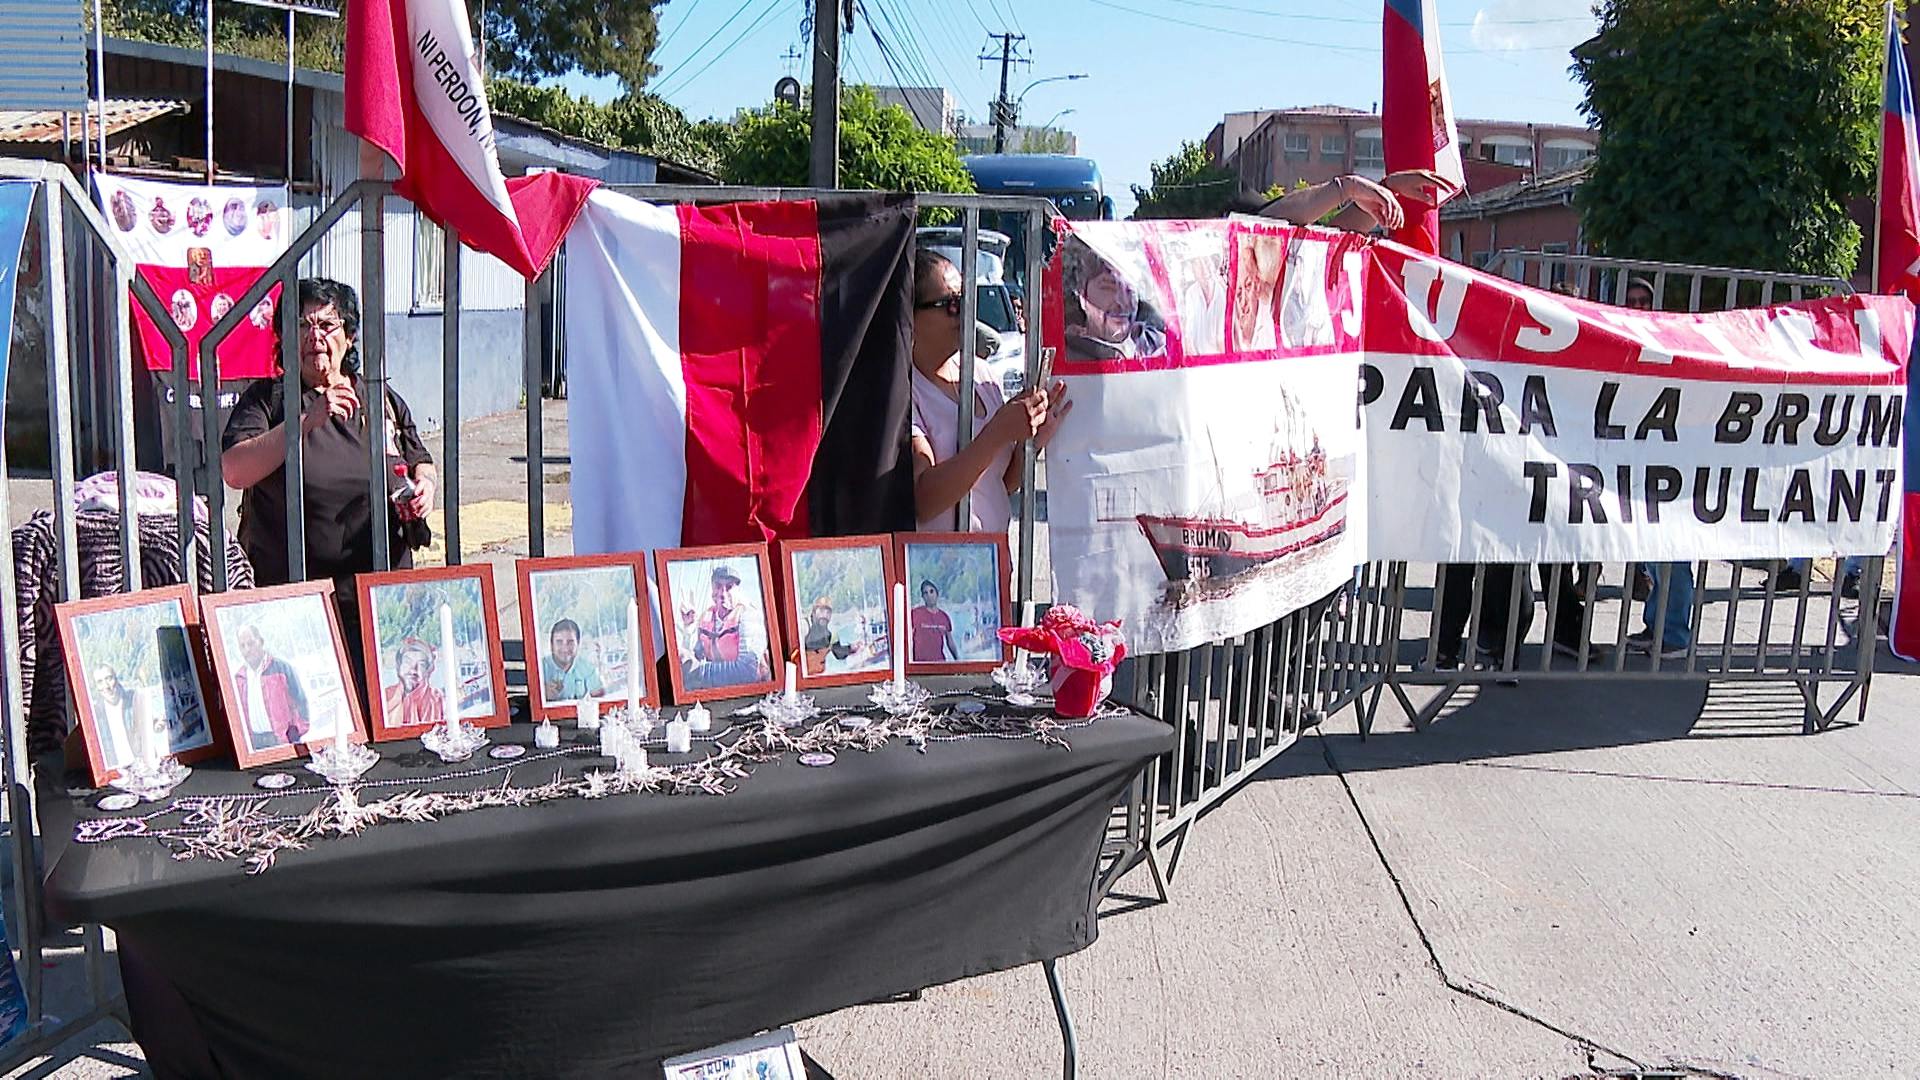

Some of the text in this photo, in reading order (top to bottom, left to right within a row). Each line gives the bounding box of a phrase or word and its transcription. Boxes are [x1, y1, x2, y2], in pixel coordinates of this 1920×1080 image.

[417, 29, 438, 59] NI
[1356, 364, 1557, 438] PARA
[1594, 381, 1682, 442] LA
[1523, 462, 1897, 524] TRIPULANT
